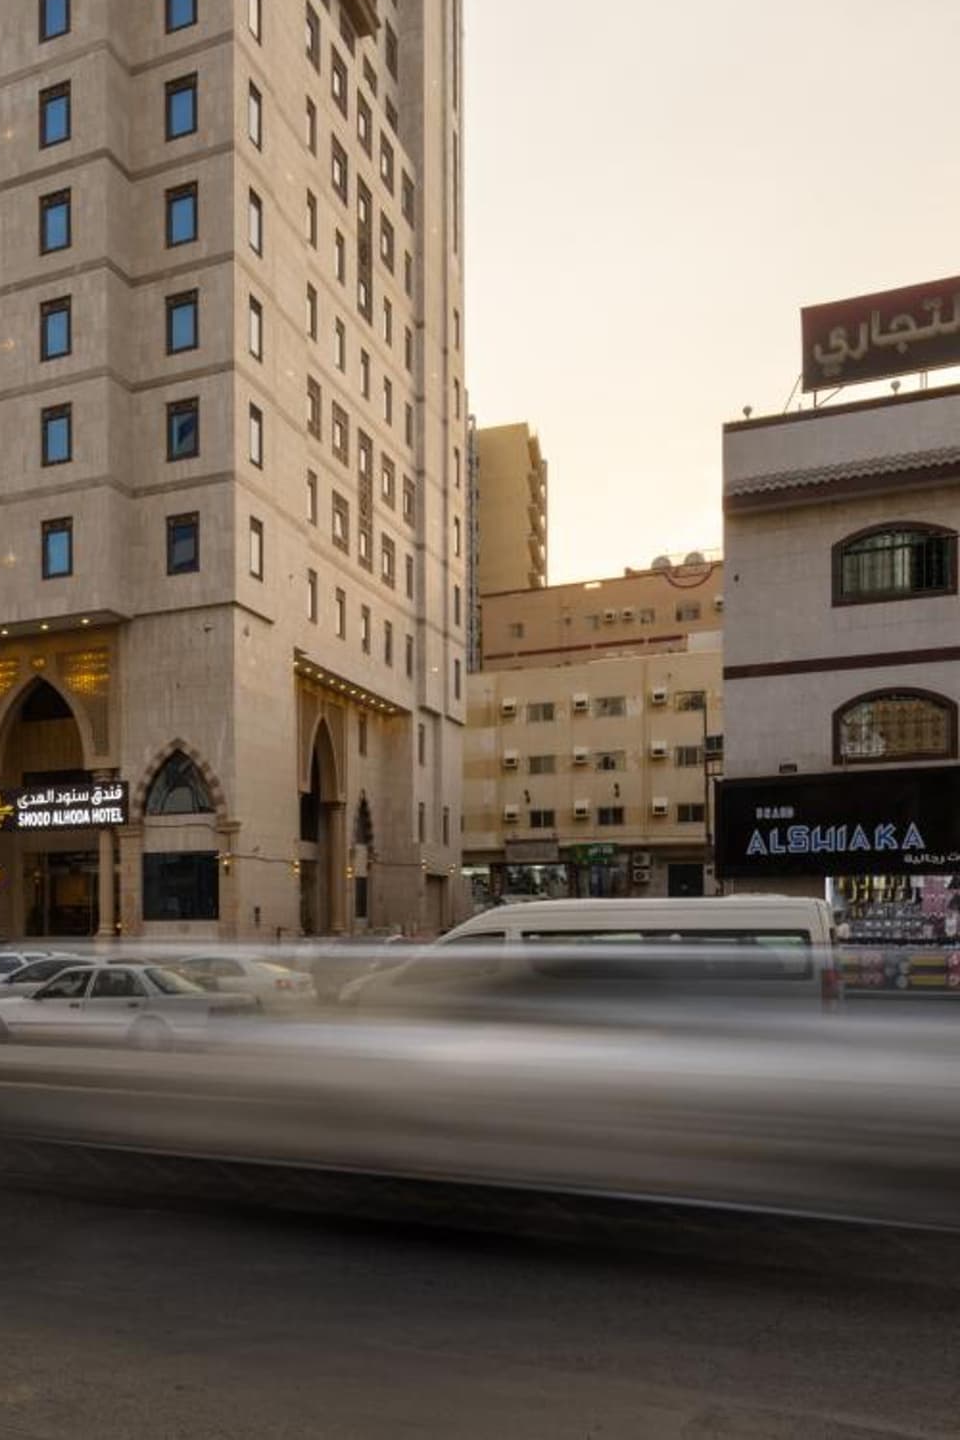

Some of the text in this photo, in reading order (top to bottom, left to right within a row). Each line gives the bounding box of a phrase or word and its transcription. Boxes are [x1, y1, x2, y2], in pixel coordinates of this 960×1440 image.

[55, 788, 90, 807] سنود
[91, 784, 123, 806] فندق
[92, 807, 124, 823] HOTEL
[745, 821, 926, 856] ALSHIAKA
